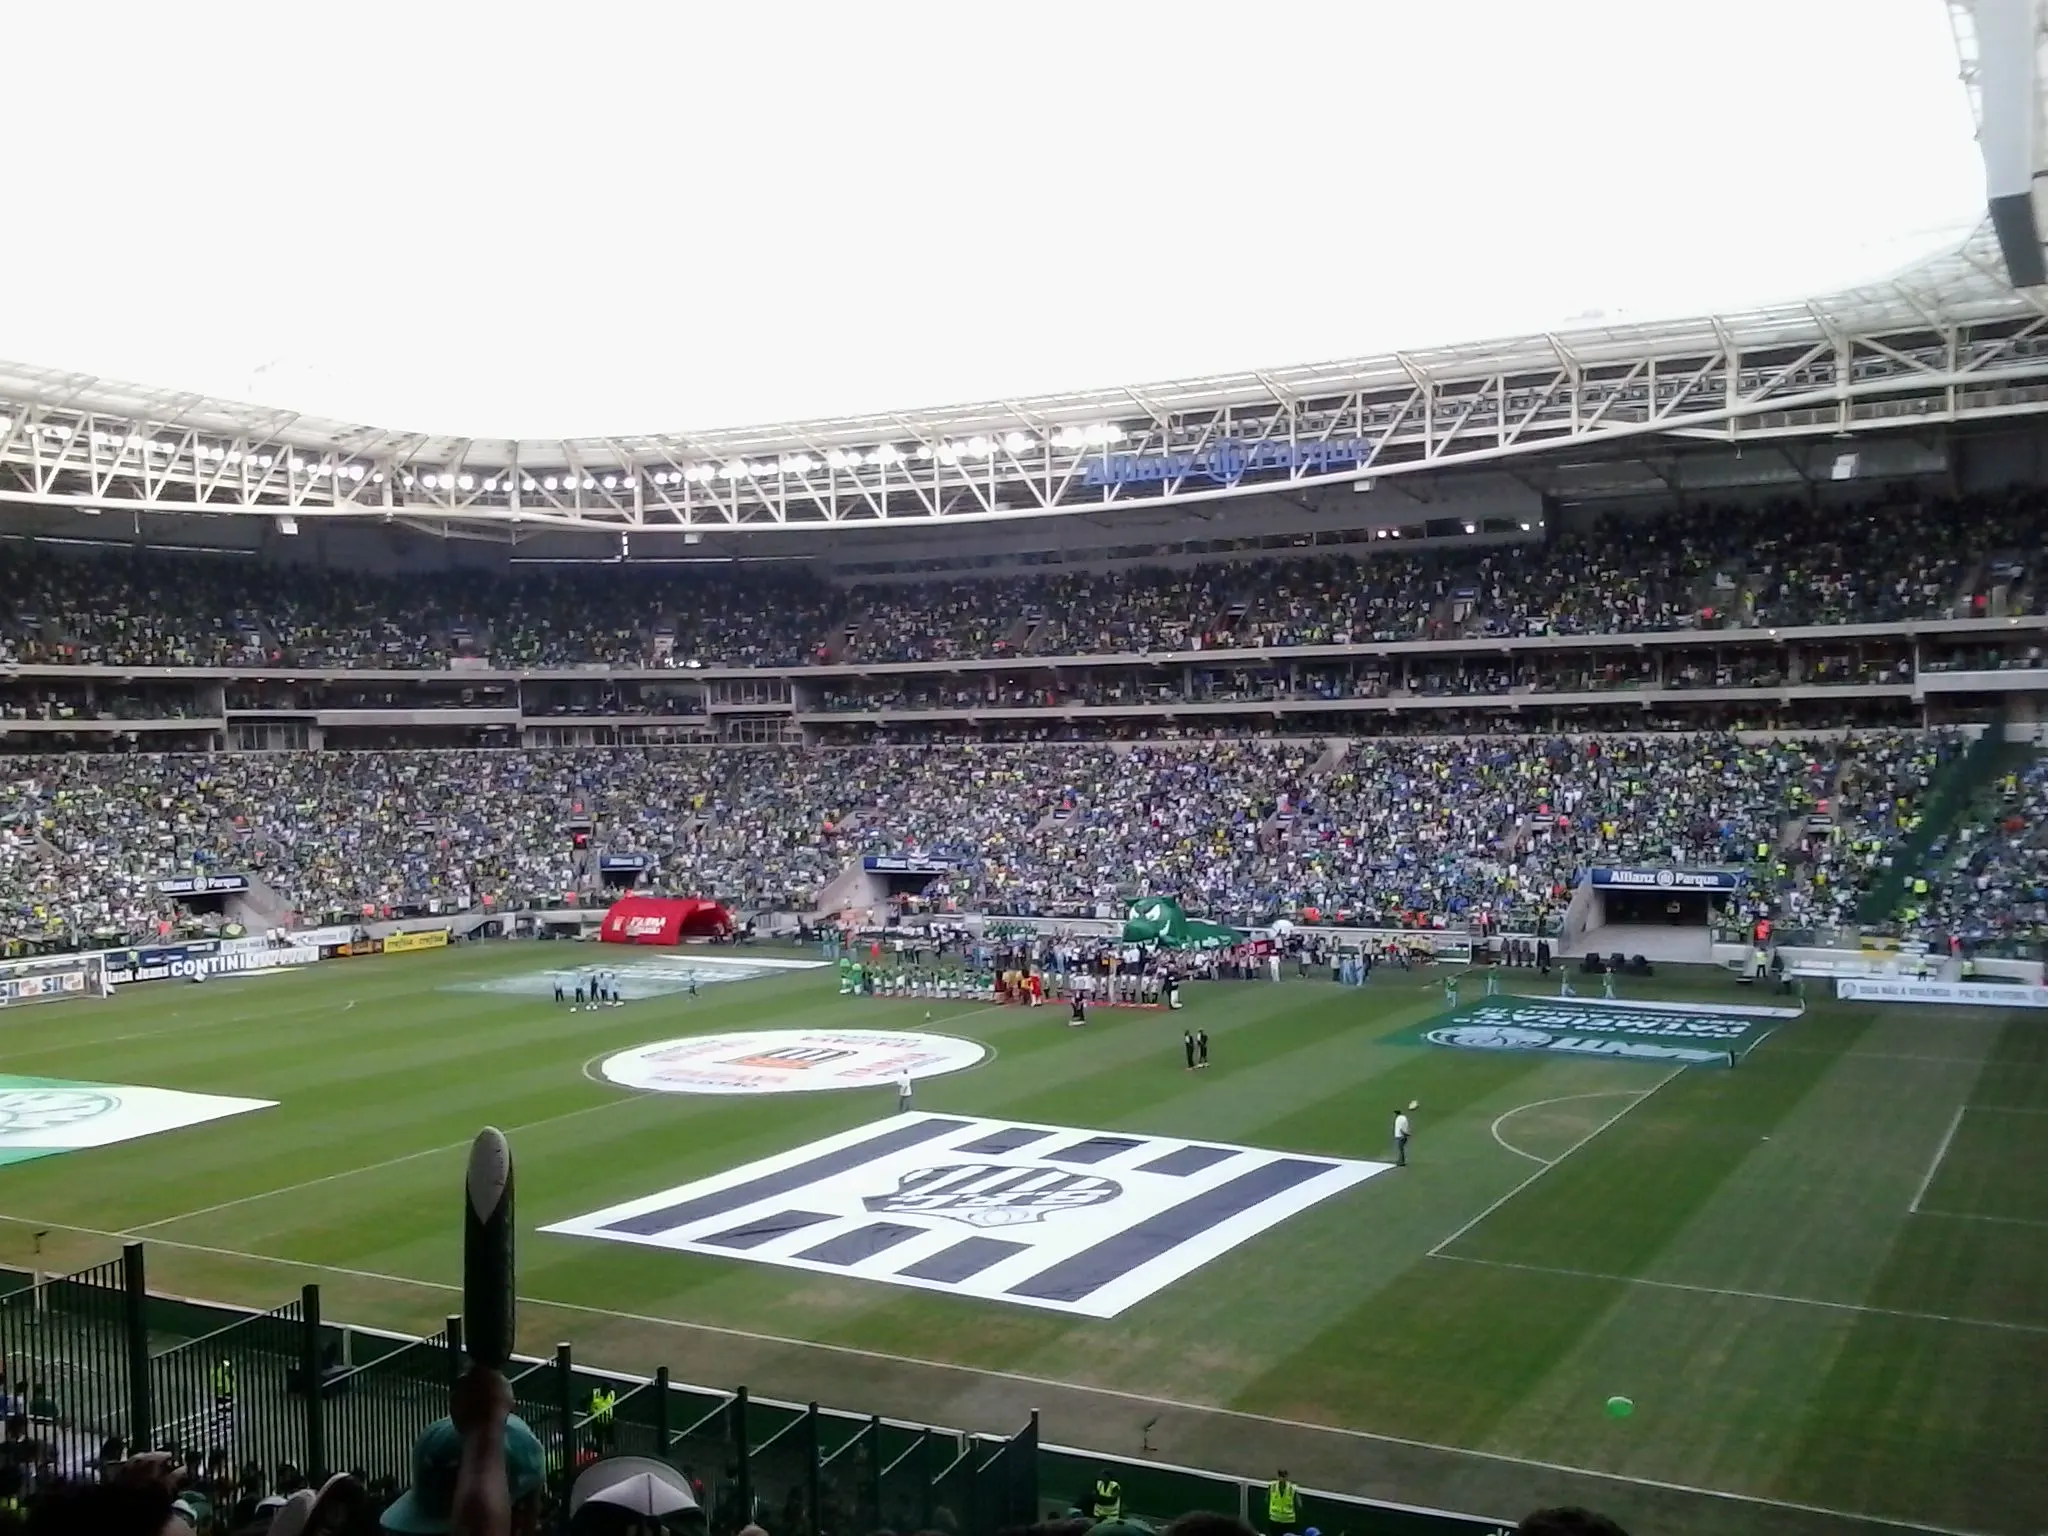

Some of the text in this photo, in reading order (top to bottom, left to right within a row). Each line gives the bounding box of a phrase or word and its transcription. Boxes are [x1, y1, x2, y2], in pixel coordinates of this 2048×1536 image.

[1083, 438, 1370, 487] Allianz Parque
[1610, 870, 1719, 888] Allianz Parque
